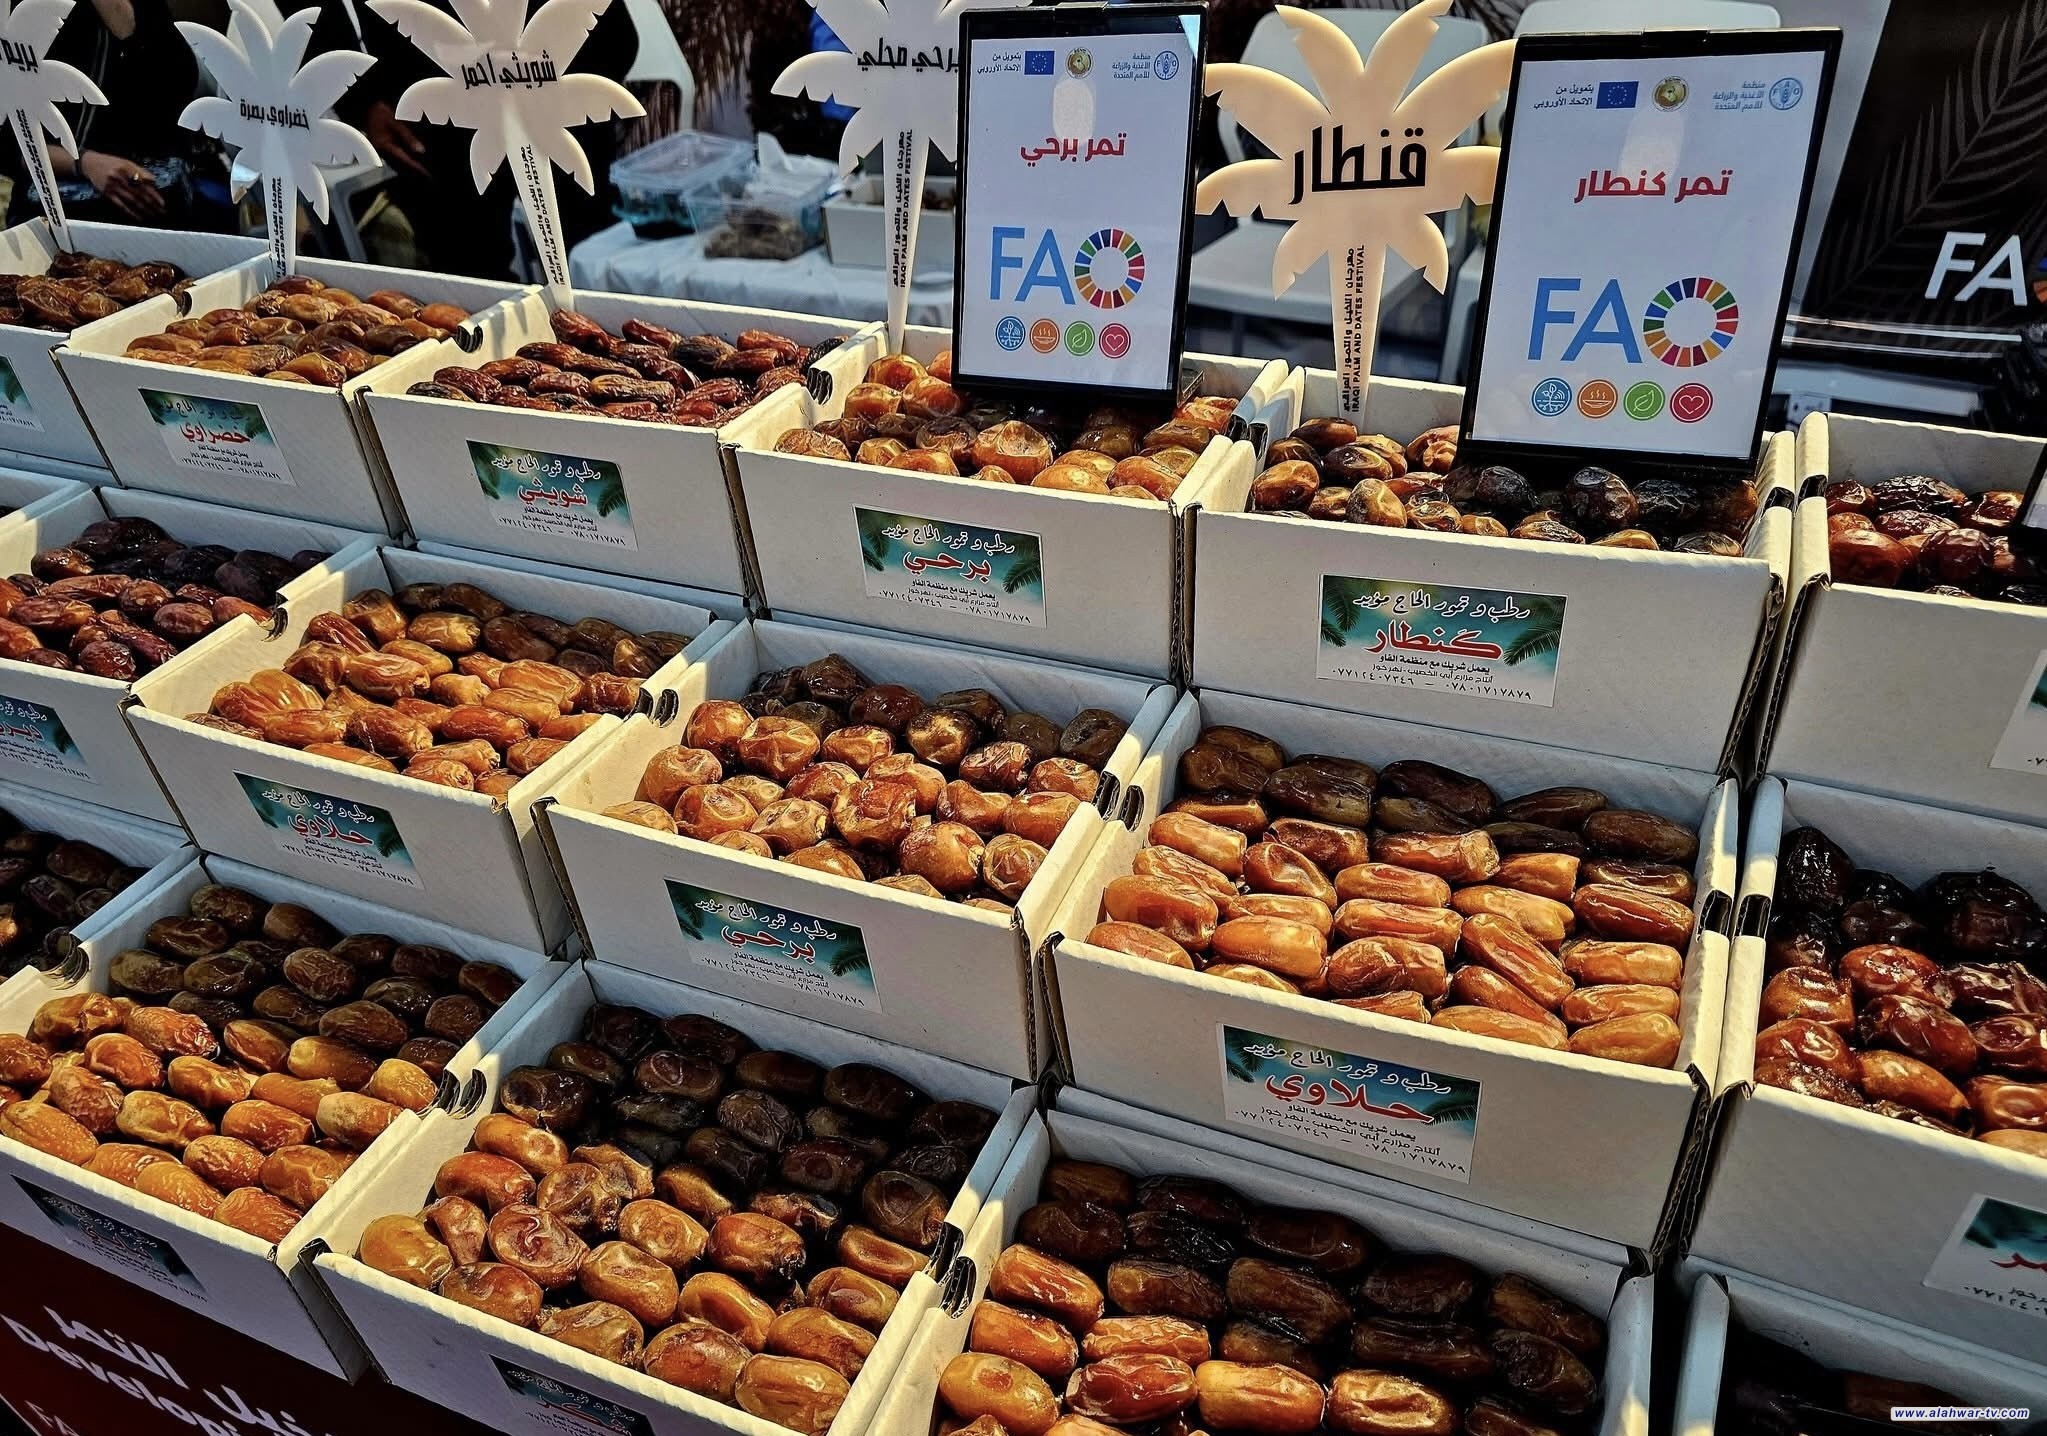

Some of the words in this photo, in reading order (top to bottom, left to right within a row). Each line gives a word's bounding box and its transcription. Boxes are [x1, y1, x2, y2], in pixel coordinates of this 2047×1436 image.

[857, 37, 908, 72] محلي
[992, 52, 1001, 62] من
[1002, 51, 1022, 61] بتمويل
[461, 52, 497, 90] احمر
[499, 50, 558, 89] شويثي
[1555, 86, 1567, 95] من
[1569, 84, 1594, 94] بتمويل
[240, 99, 266, 124] بصرة
[267, 104, 310, 130] خضراوي
[896, 131, 905, 169] مهرجان
[905, 130, 913, 175] FESTIVAL
[1020, 136, 1080, 167] برحي
[1084, 132, 1127, 163] تمر
[526, 144, 541, 186] FESTIVAL
[1287, 124, 1427, 205] قنطار
[903, 177, 911, 208] DATES
[1573, 169, 1667, 204] كنطار
[1674, 168, 1734, 204] تمر
[537, 188, 548, 215] DATES
[544, 217, 553, 235] AND
[990, 226, 1146, 309] FAO
[1345, 248, 1354, 288] مهرجان
[1355, 245, 1365, 294] FESTIVAL
[1344, 294, 1353, 325] النخيل
[1354, 297, 1363, 330] DATES
[1527, 276, 1740, 368] FAO
[1343, 329, 1353, 369] والتمور
[1354, 332, 1362, 354] AND
[1353, 357, 1361, 383] PALM
[1352, 386, 1361, 412] IRAQI
[180, 421, 251, 445] خضراوي
[516, 453, 540, 475] الحاج
[541, 459, 562, 478] تمور
[517, 477, 589, 509] شويثي
[882, 524, 909, 539] مؤيد
[912, 524, 940, 545] الحاج
[943, 531, 969, 550] تمور
[970, 538, 982, 551] و
[984, 534, 1016, 557] رطب
[903, 552, 992, 585] برحي
[1352, 592, 1390, 609] مؤيد
[1392, 589, 1431, 615] الحاج
[1432, 596, 1470, 617] تمور
[1469, 603, 1487, 617] و
[1487, 596, 1532, 624] رطب
[965, 606, 1031, 624] ٠٧٨٠١٧١٧٨٧٩
[1379, 653, 1398, 663] الفاو
[1399, 655, 1428, 666] منظمة
[1429, 661, 1440, 670] مع
[1441, 661, 1467, 672] شريك
[1332, 667, 1415, 686] ٠٧٧١٢٤٠٧٣٤٦
[1407, 669, 1438, 678] الخصيب
[1454, 674, 1474, 682] مزارع
[1466, 664, 1490, 676] يعمل
[1446, 682, 1532, 700] ٠٧٨٠١٧١٧٨٧٩
[288, 813, 375, 846] حلاوي
[695, 899, 724, 914] مؤيد
[727, 902, 758, 921] الحاج
[759, 914, 787, 930] تمور
[789, 921, 802, 933] و
[803, 920, 837, 941] رطب
[721, 925, 816, 965] برحي
[794, 982, 865, 1007] ٠٧٨٠١٧١٧٨٧٩
[1243, 1043, 1288, 1059] مؤيد
[1289, 1050, 1334, 1068] الحاج
[1337, 1063, 1379, 1079] تمور
[1380, 1073, 1399, 1084] و
[1401, 1072, 1451, 1094] رطب
[1264, 1073, 1436, 1125] حلاوي
[1287, 1104, 1308, 1114] الفاو
[1235, 1109, 1329, 1139] ٠٧٧١٢٤٠٧٣٤٦
[1284, 1113, 1304, 1122] نهر
[1309, 1108, 1344, 1122] منظمة
[1345, 1119, 1357, 1127] مع
[1312, 1120, 1357, 1135] الخصيب
[1359, 1122, 1388, 1134] شريك
[1389, 1129, 1417, 1142] يعمل
[1381, 1139, 1411, 1149] مزارع
[1366, 1143, 1466, 1173] ٠٧٨٠١٧١٧٨٧٩
[43, 1305, 190, 1391] التمر
